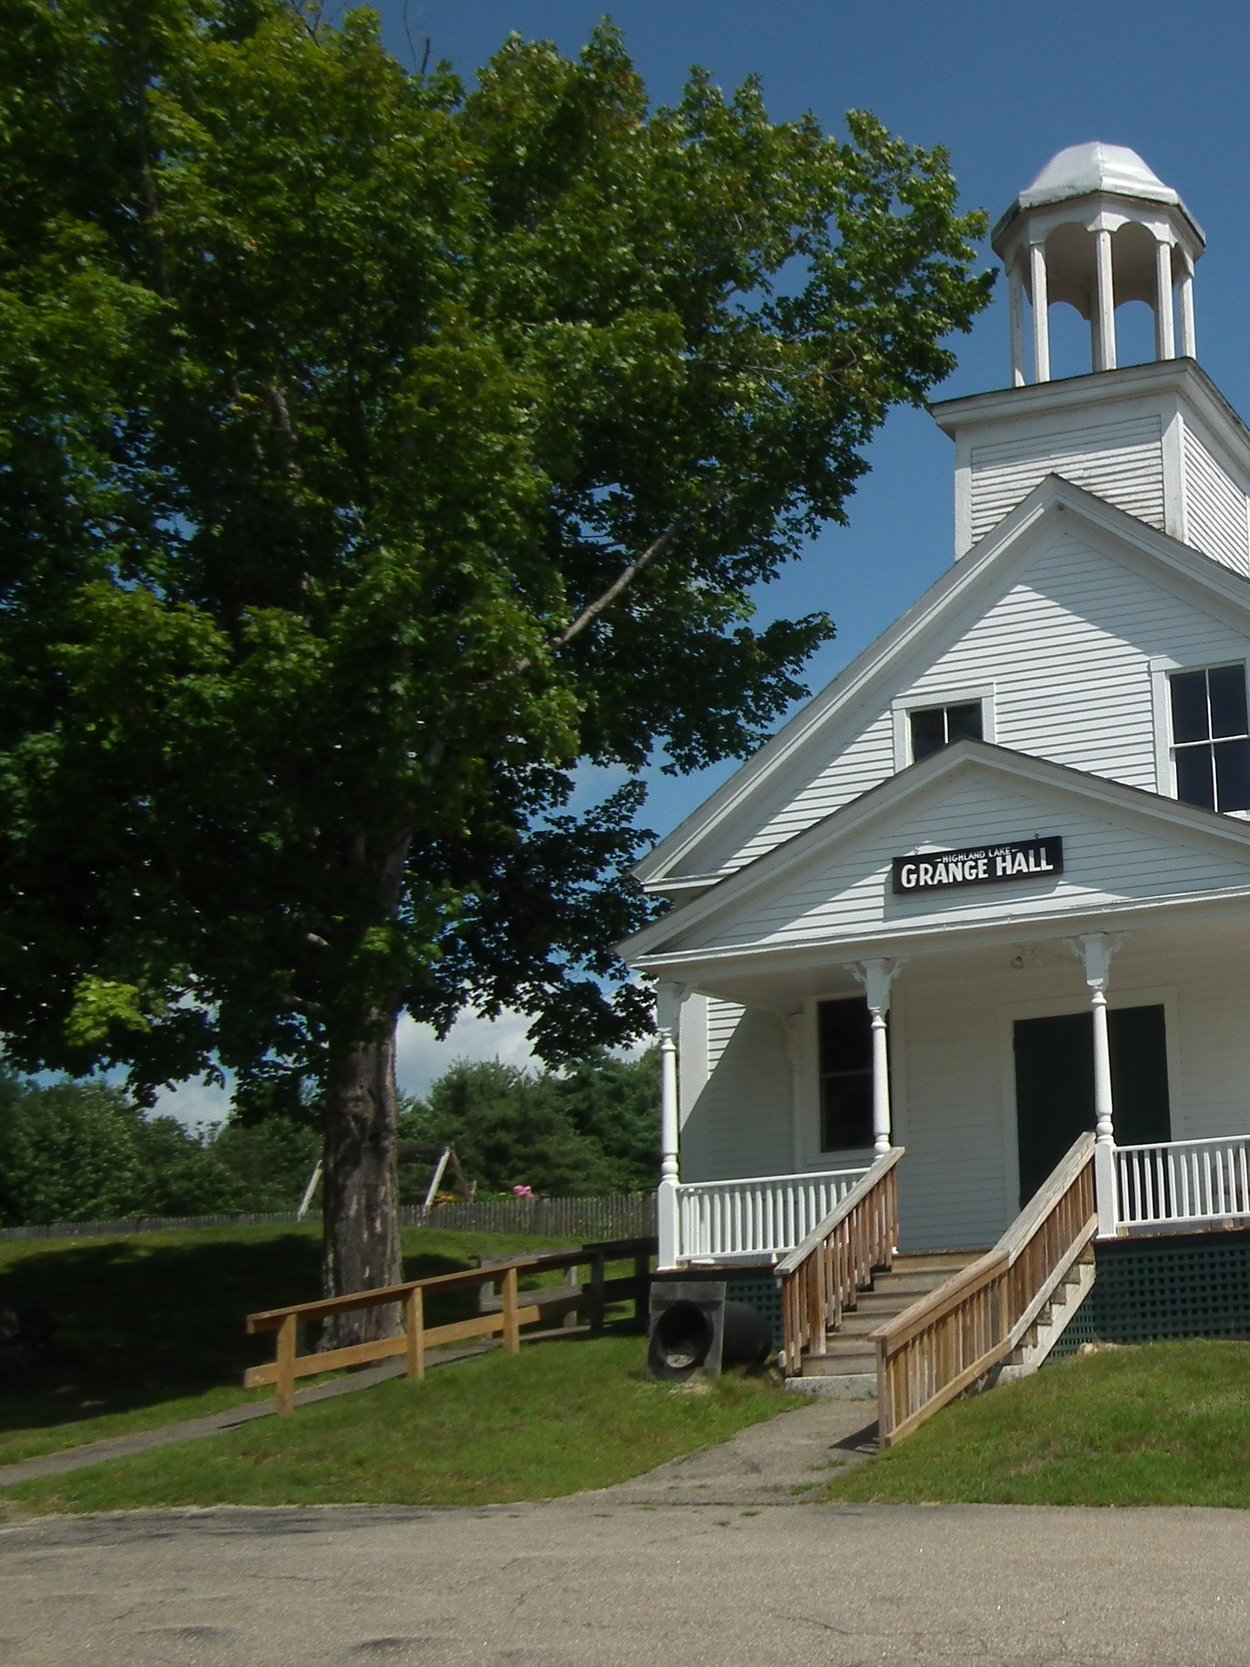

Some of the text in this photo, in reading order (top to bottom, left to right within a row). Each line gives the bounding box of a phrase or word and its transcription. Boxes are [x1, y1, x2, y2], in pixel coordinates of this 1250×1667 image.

[901, 847, 1054, 888] GRANGE HALL
[942, 847, 1011, 863] HIGHLAND LAKE
